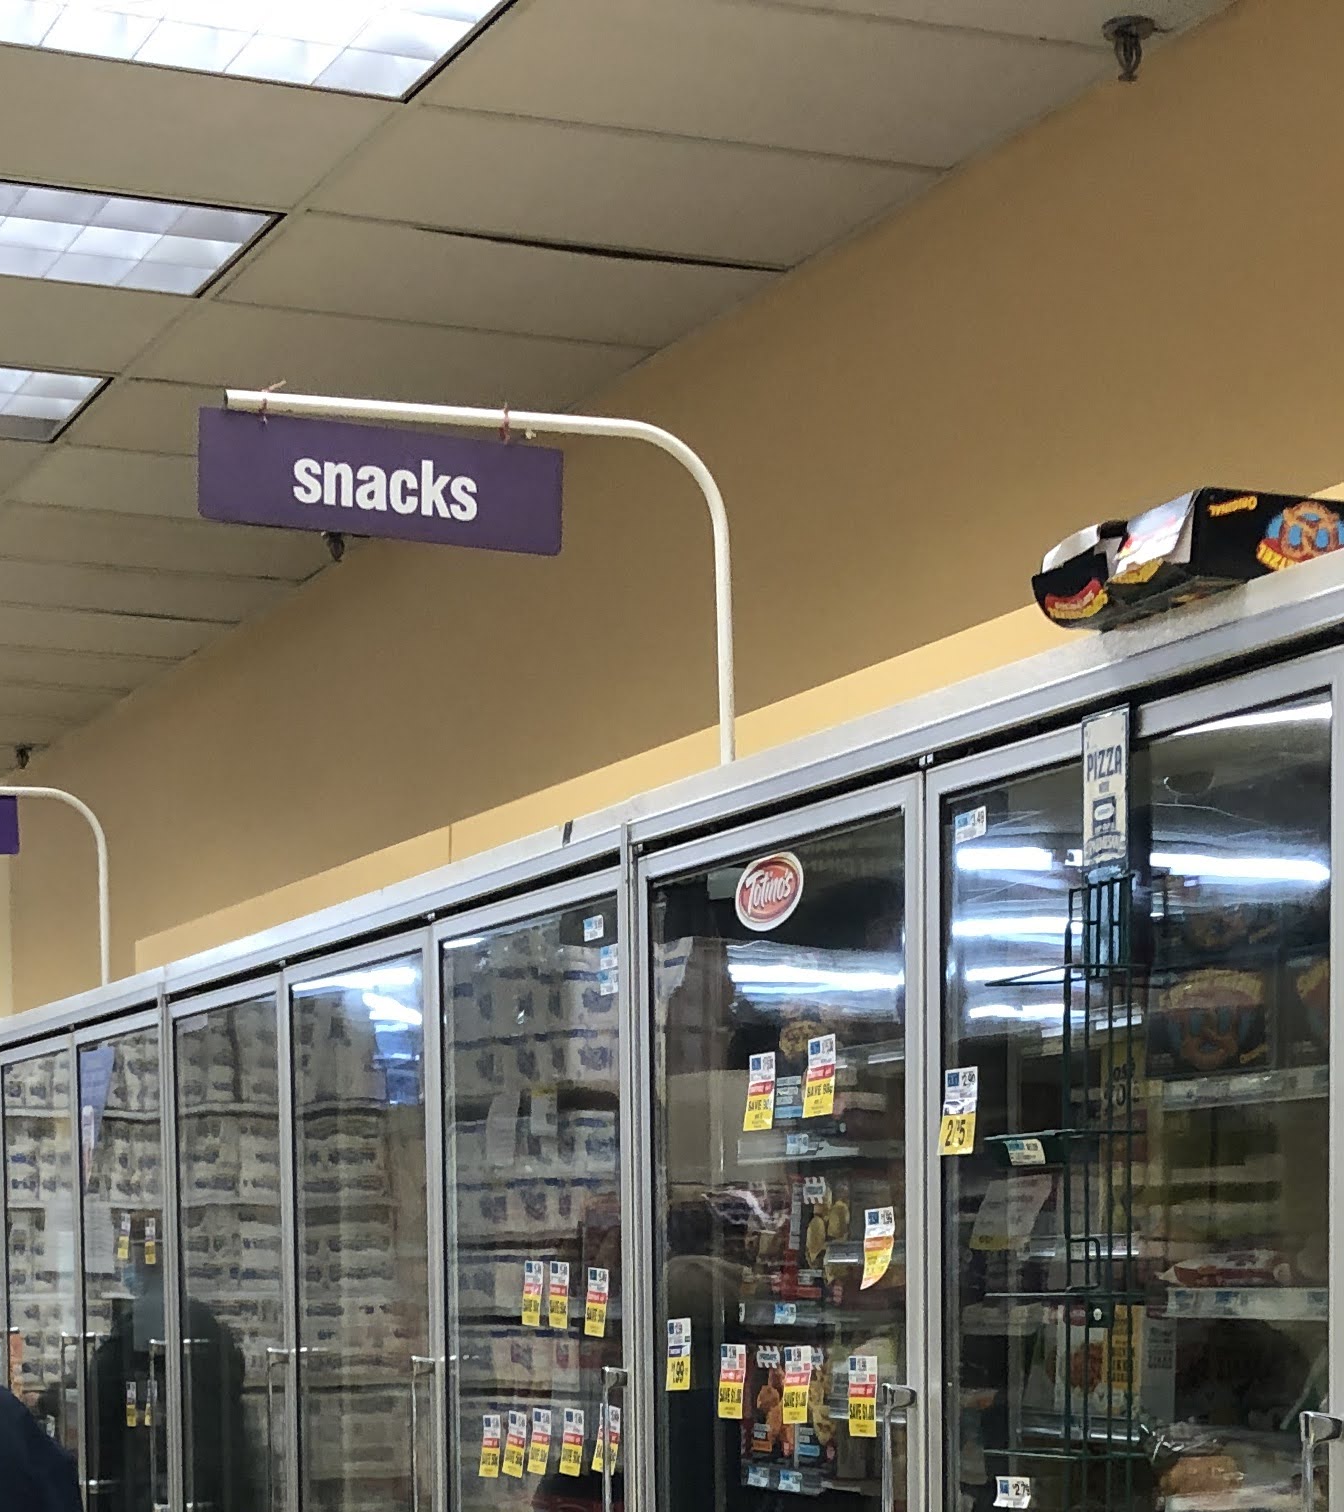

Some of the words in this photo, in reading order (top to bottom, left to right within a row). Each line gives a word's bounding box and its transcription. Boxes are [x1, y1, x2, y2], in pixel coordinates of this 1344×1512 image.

[292, 456, 479, 522] snacks
[1086, 744, 1123, 783] PIZZA
[745, 867, 793, 916] Totino's
